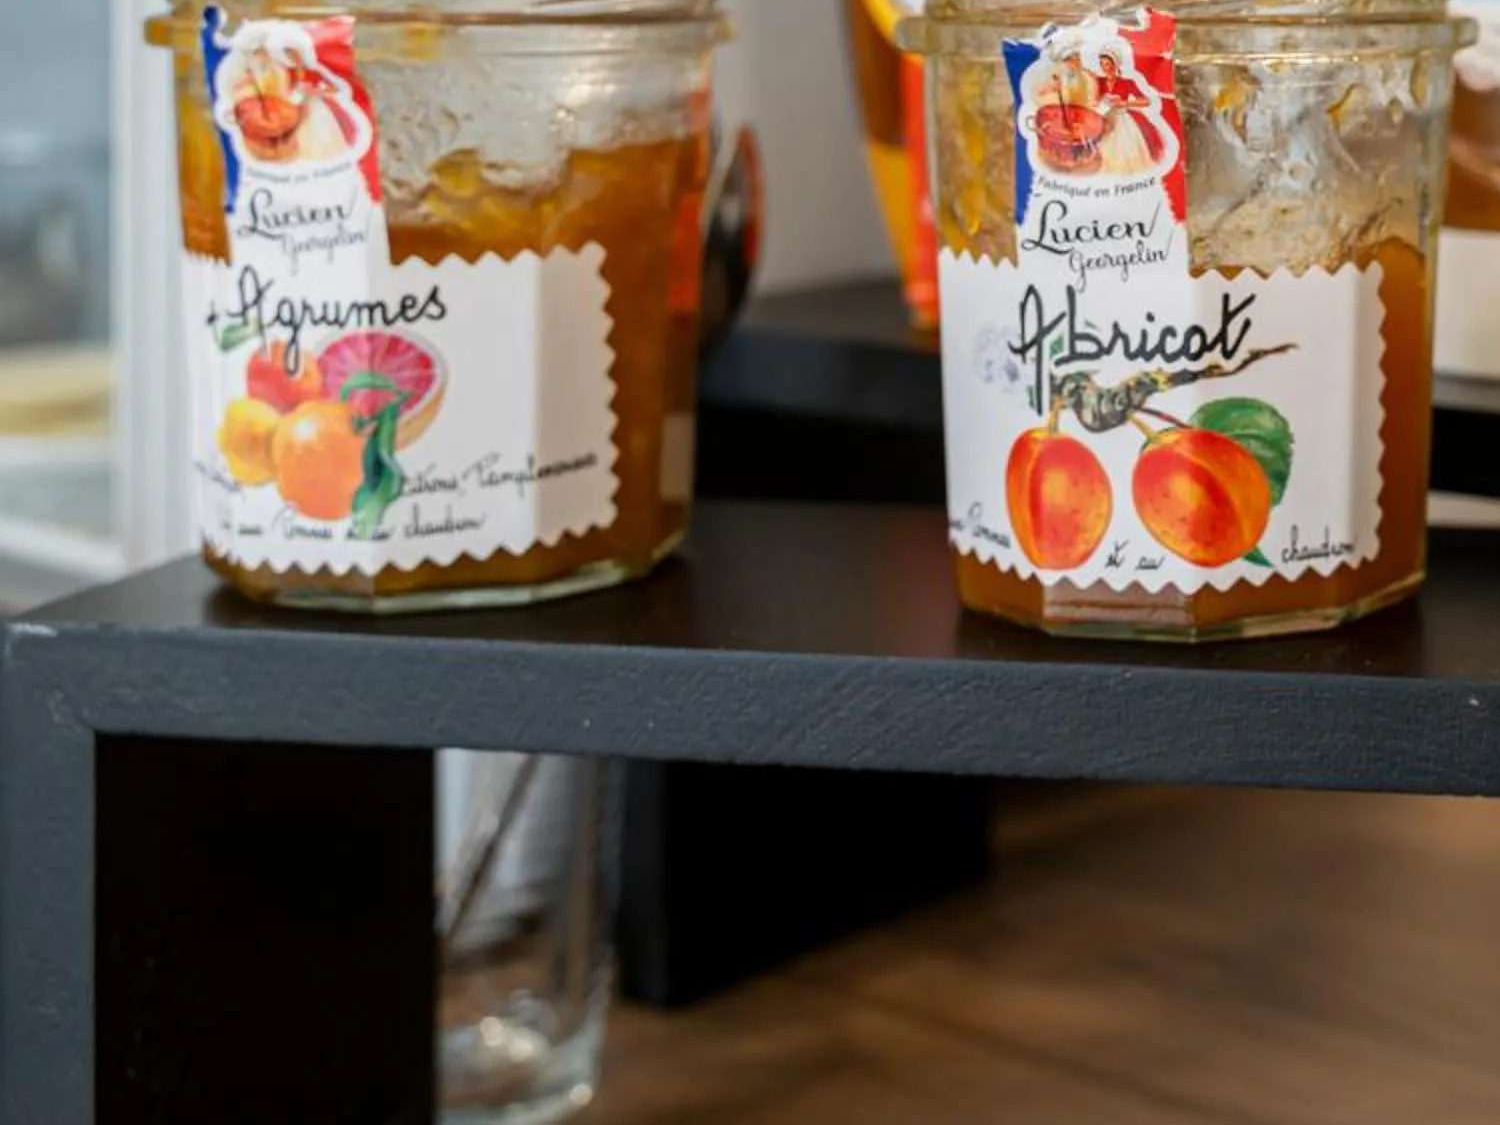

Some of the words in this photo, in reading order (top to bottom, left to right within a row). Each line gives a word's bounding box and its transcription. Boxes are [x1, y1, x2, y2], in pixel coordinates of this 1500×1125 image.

[237, 185, 358, 241] Lucien
[1093, 188, 1110, 198] en
[1114, 176, 1156, 196] France
[1021, 199, 1163, 255] Lucien
[1069, 228, 1175, 293] Georgelin
[224, 264, 447, 375] Agrumes
[1007, 284, 1257, 417] Abricot
